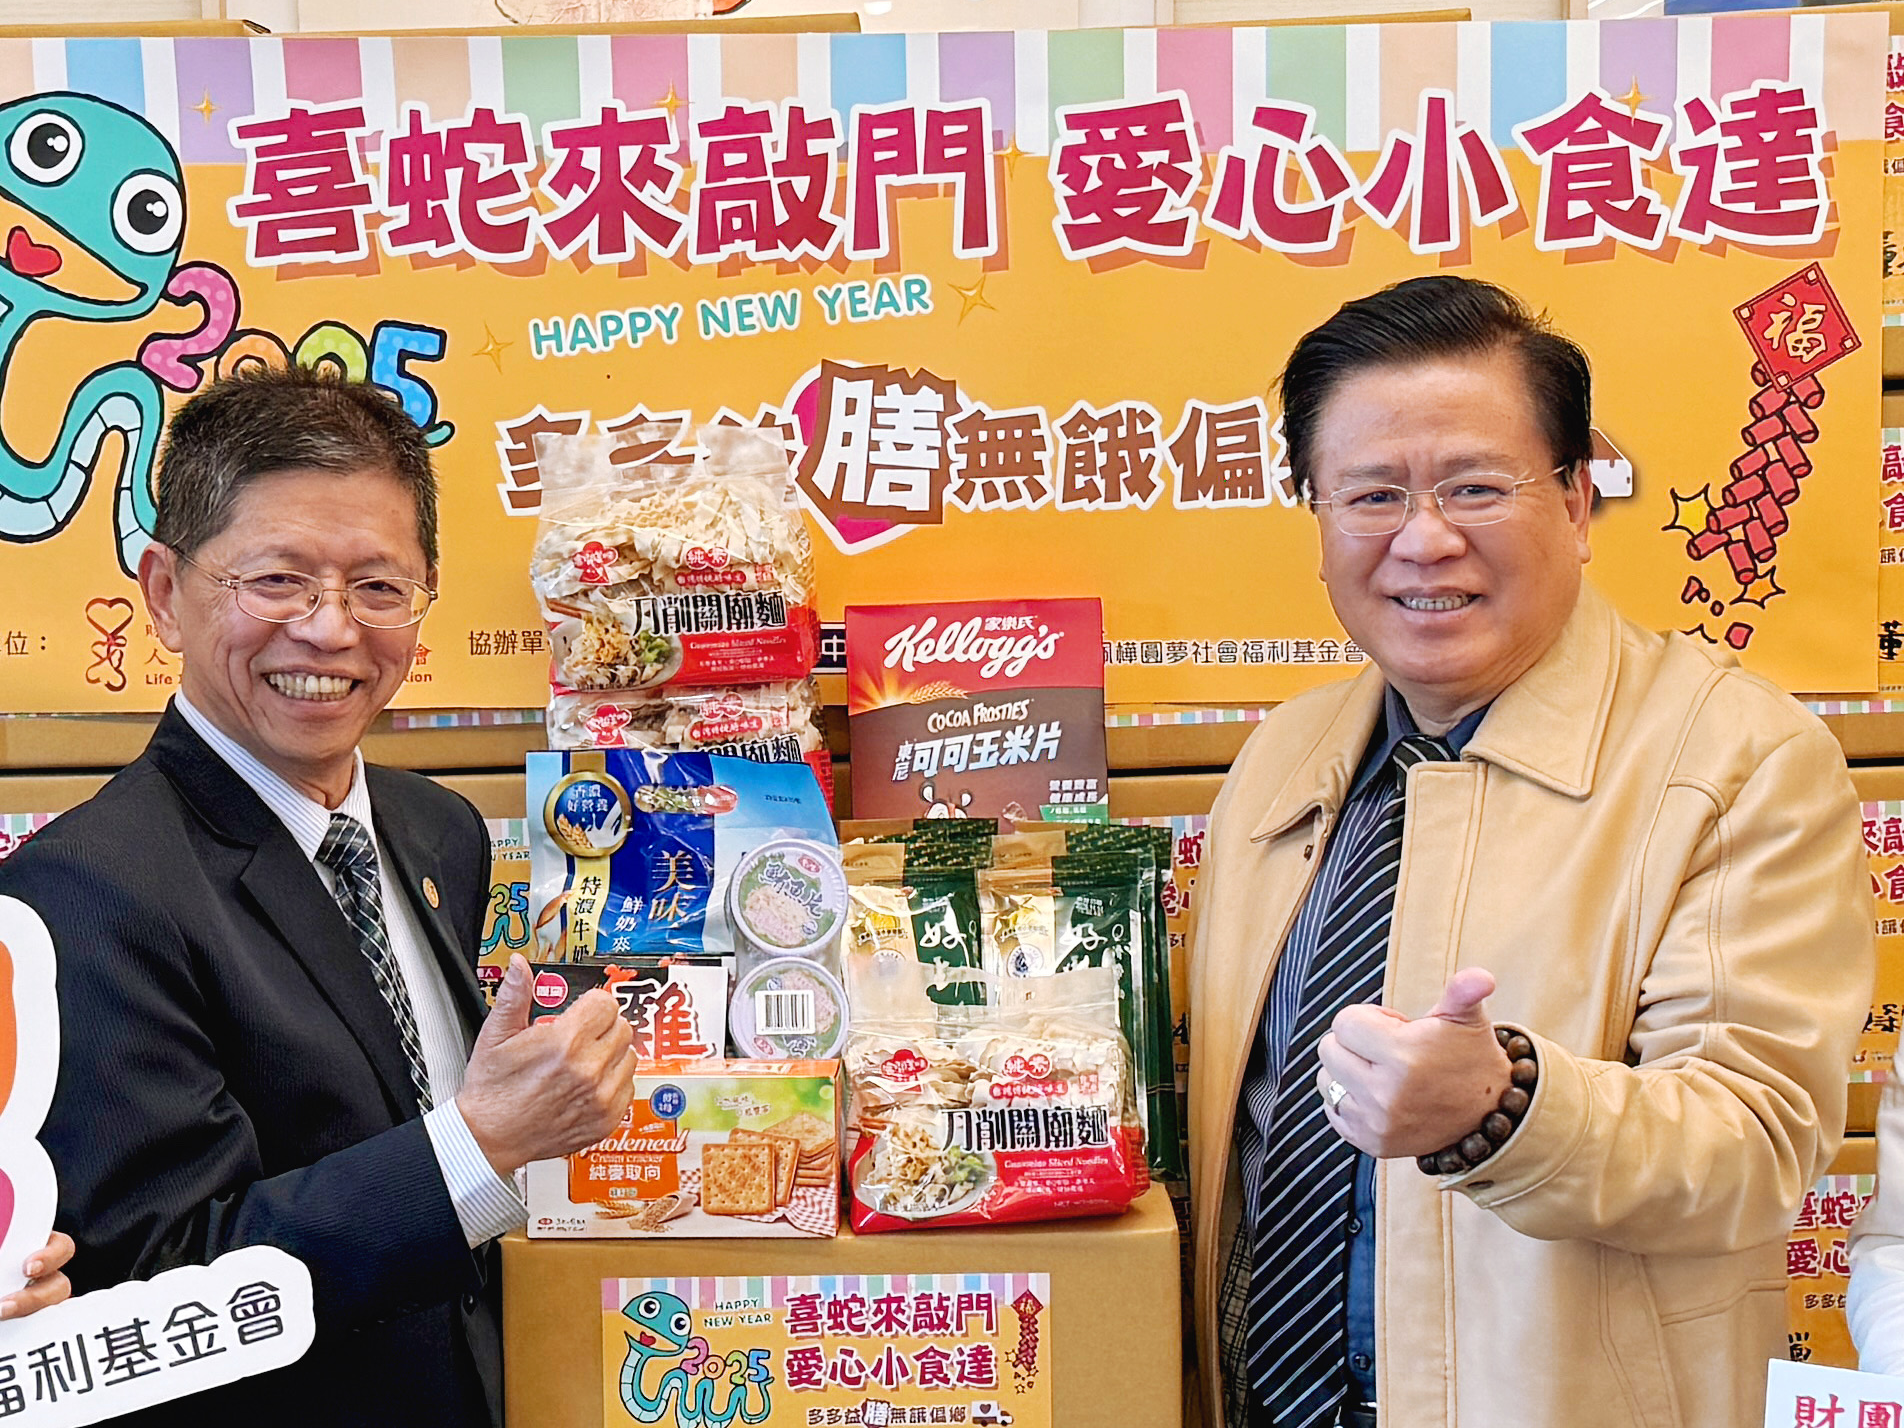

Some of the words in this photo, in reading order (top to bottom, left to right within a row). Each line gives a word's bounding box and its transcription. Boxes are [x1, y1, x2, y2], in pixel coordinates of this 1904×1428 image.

[236, 106, 989, 264] 喜蛇來敲門
[1058, 84, 1827, 254] 愛心小食達
[533, 304, 681, 357] HAPPY
[698, 290, 797, 337] NEW
[816, 278, 930, 327] YEAR
[1767, 292, 1830, 367] 福
[882, 615, 1058, 680] Kellogg's
[145, 673, 173, 686] Life
[926, 710, 971, 734] COCOA
[973, 699, 1031, 725] FROSTIES
[911, 720, 1063, 780] 可可玉米片
[785, 1293, 995, 1333] 喜蛇來敲門
[681, 1336, 772, 1380] 2025
[785, 1344, 996, 1388] 愛心小食達
